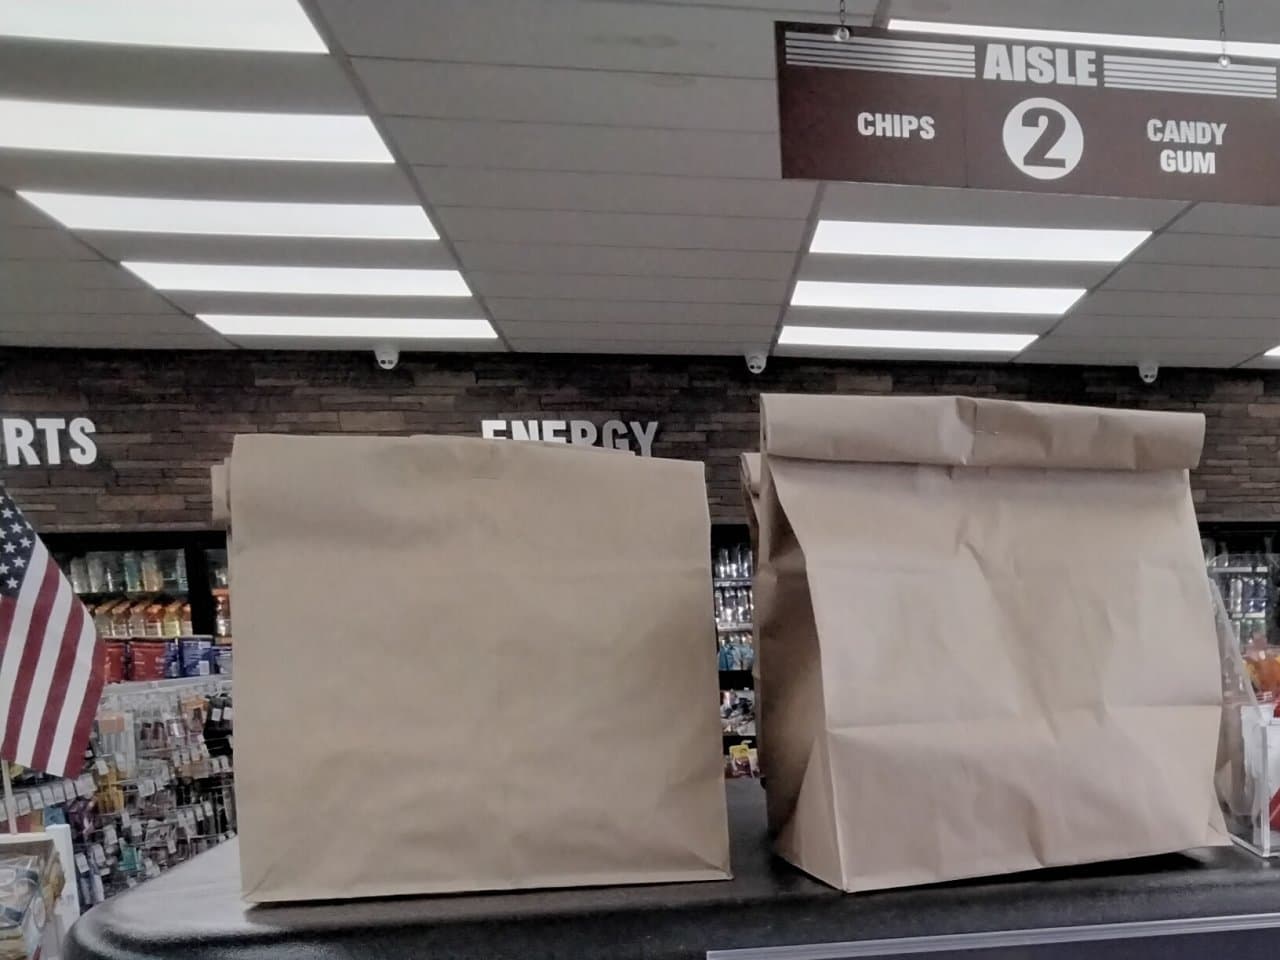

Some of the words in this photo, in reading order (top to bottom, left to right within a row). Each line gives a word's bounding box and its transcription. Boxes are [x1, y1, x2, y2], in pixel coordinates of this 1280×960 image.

[983, 44, 1097, 86] AISLE
[857, 112, 935, 140] CHIPS
[1021, 107, 1067, 169] 2
[1147, 119, 1227, 146] CANDY
[1160, 150, 1216, 174] GUM
